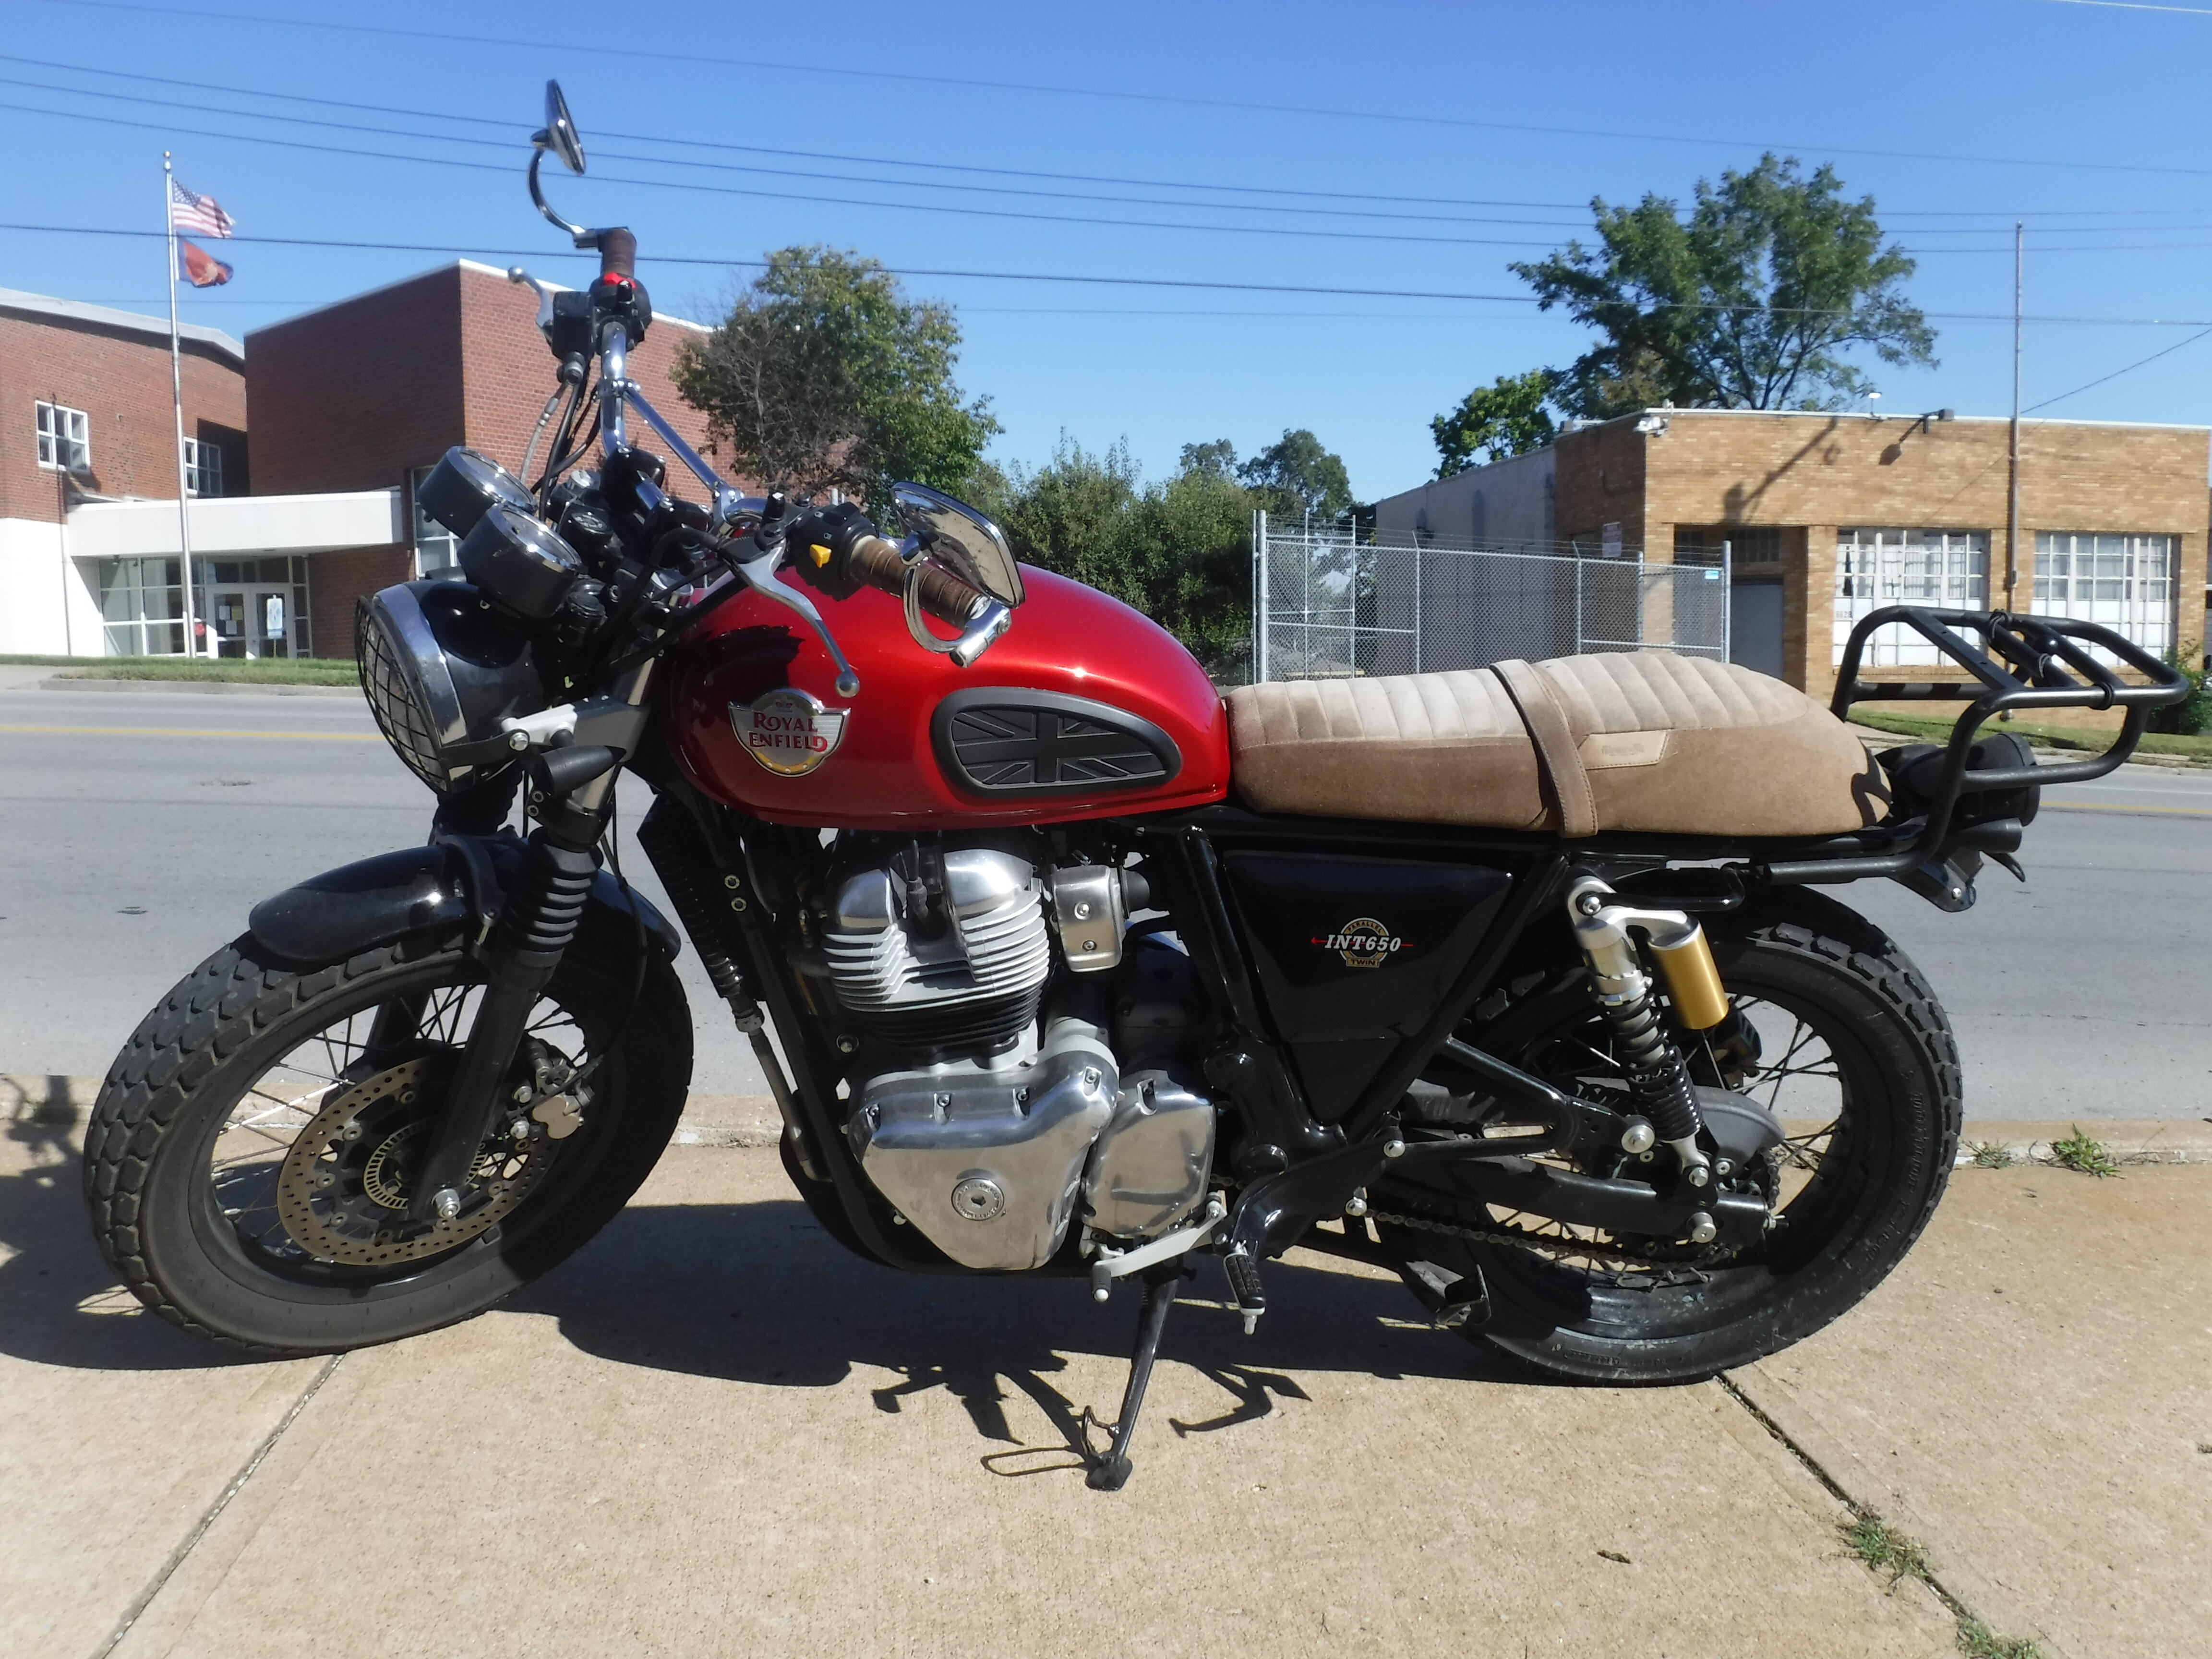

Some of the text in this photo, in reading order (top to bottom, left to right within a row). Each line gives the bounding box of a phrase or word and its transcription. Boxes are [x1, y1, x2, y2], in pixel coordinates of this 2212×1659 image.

[754, 712, 817, 732] ROYAL
[749, 732, 828, 752] ENFIELD
[1347, 921, 1382, 934] PARALLEL
[1324, 934, 1401, 951] INT650
